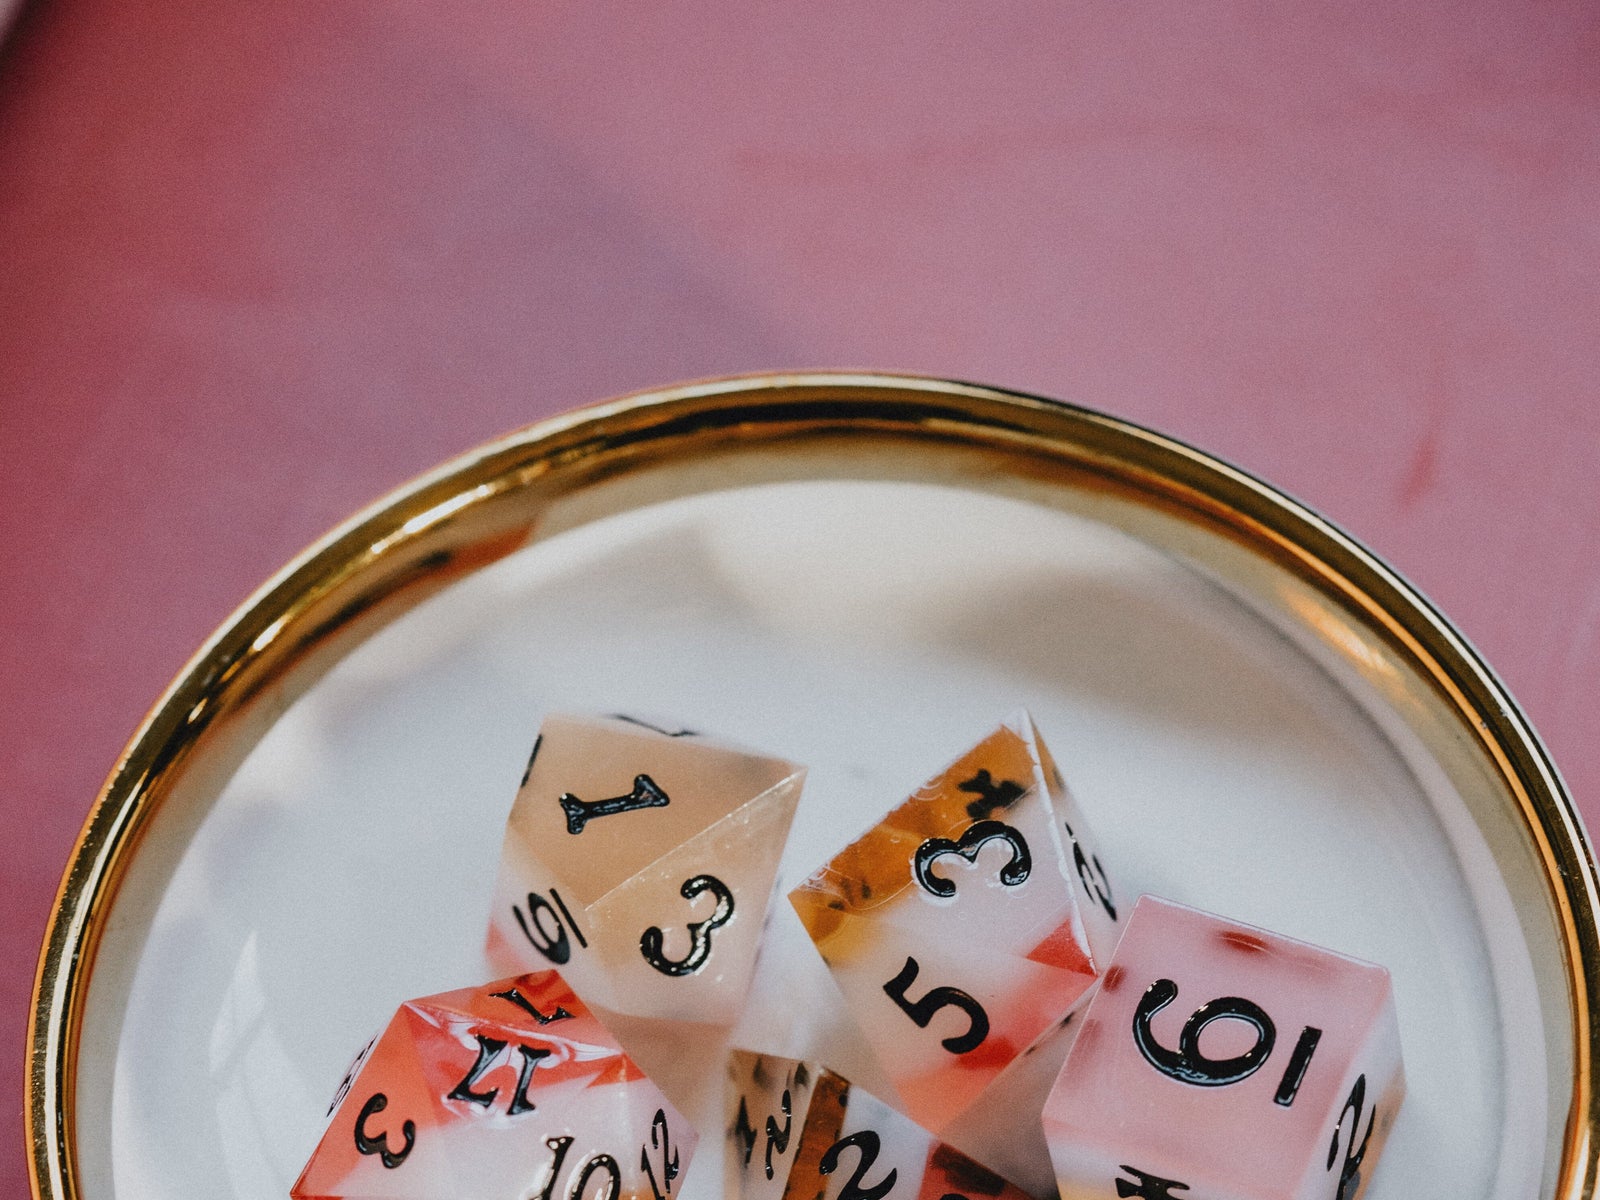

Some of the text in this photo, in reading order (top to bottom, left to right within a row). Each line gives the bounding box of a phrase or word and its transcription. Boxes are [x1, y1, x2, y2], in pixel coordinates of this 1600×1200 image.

[559, 774, 670, 834] 1
[914, 820, 1032, 898] 3
[512, 888, 588, 965] 6
[639, 874, 735, 977] 3
[883, 956, 990, 1055] 5
[1132, 978, 1323, 1107] 6
[447, 1034, 551, 1116] 17
[354, 1092, 416, 1169] 3
